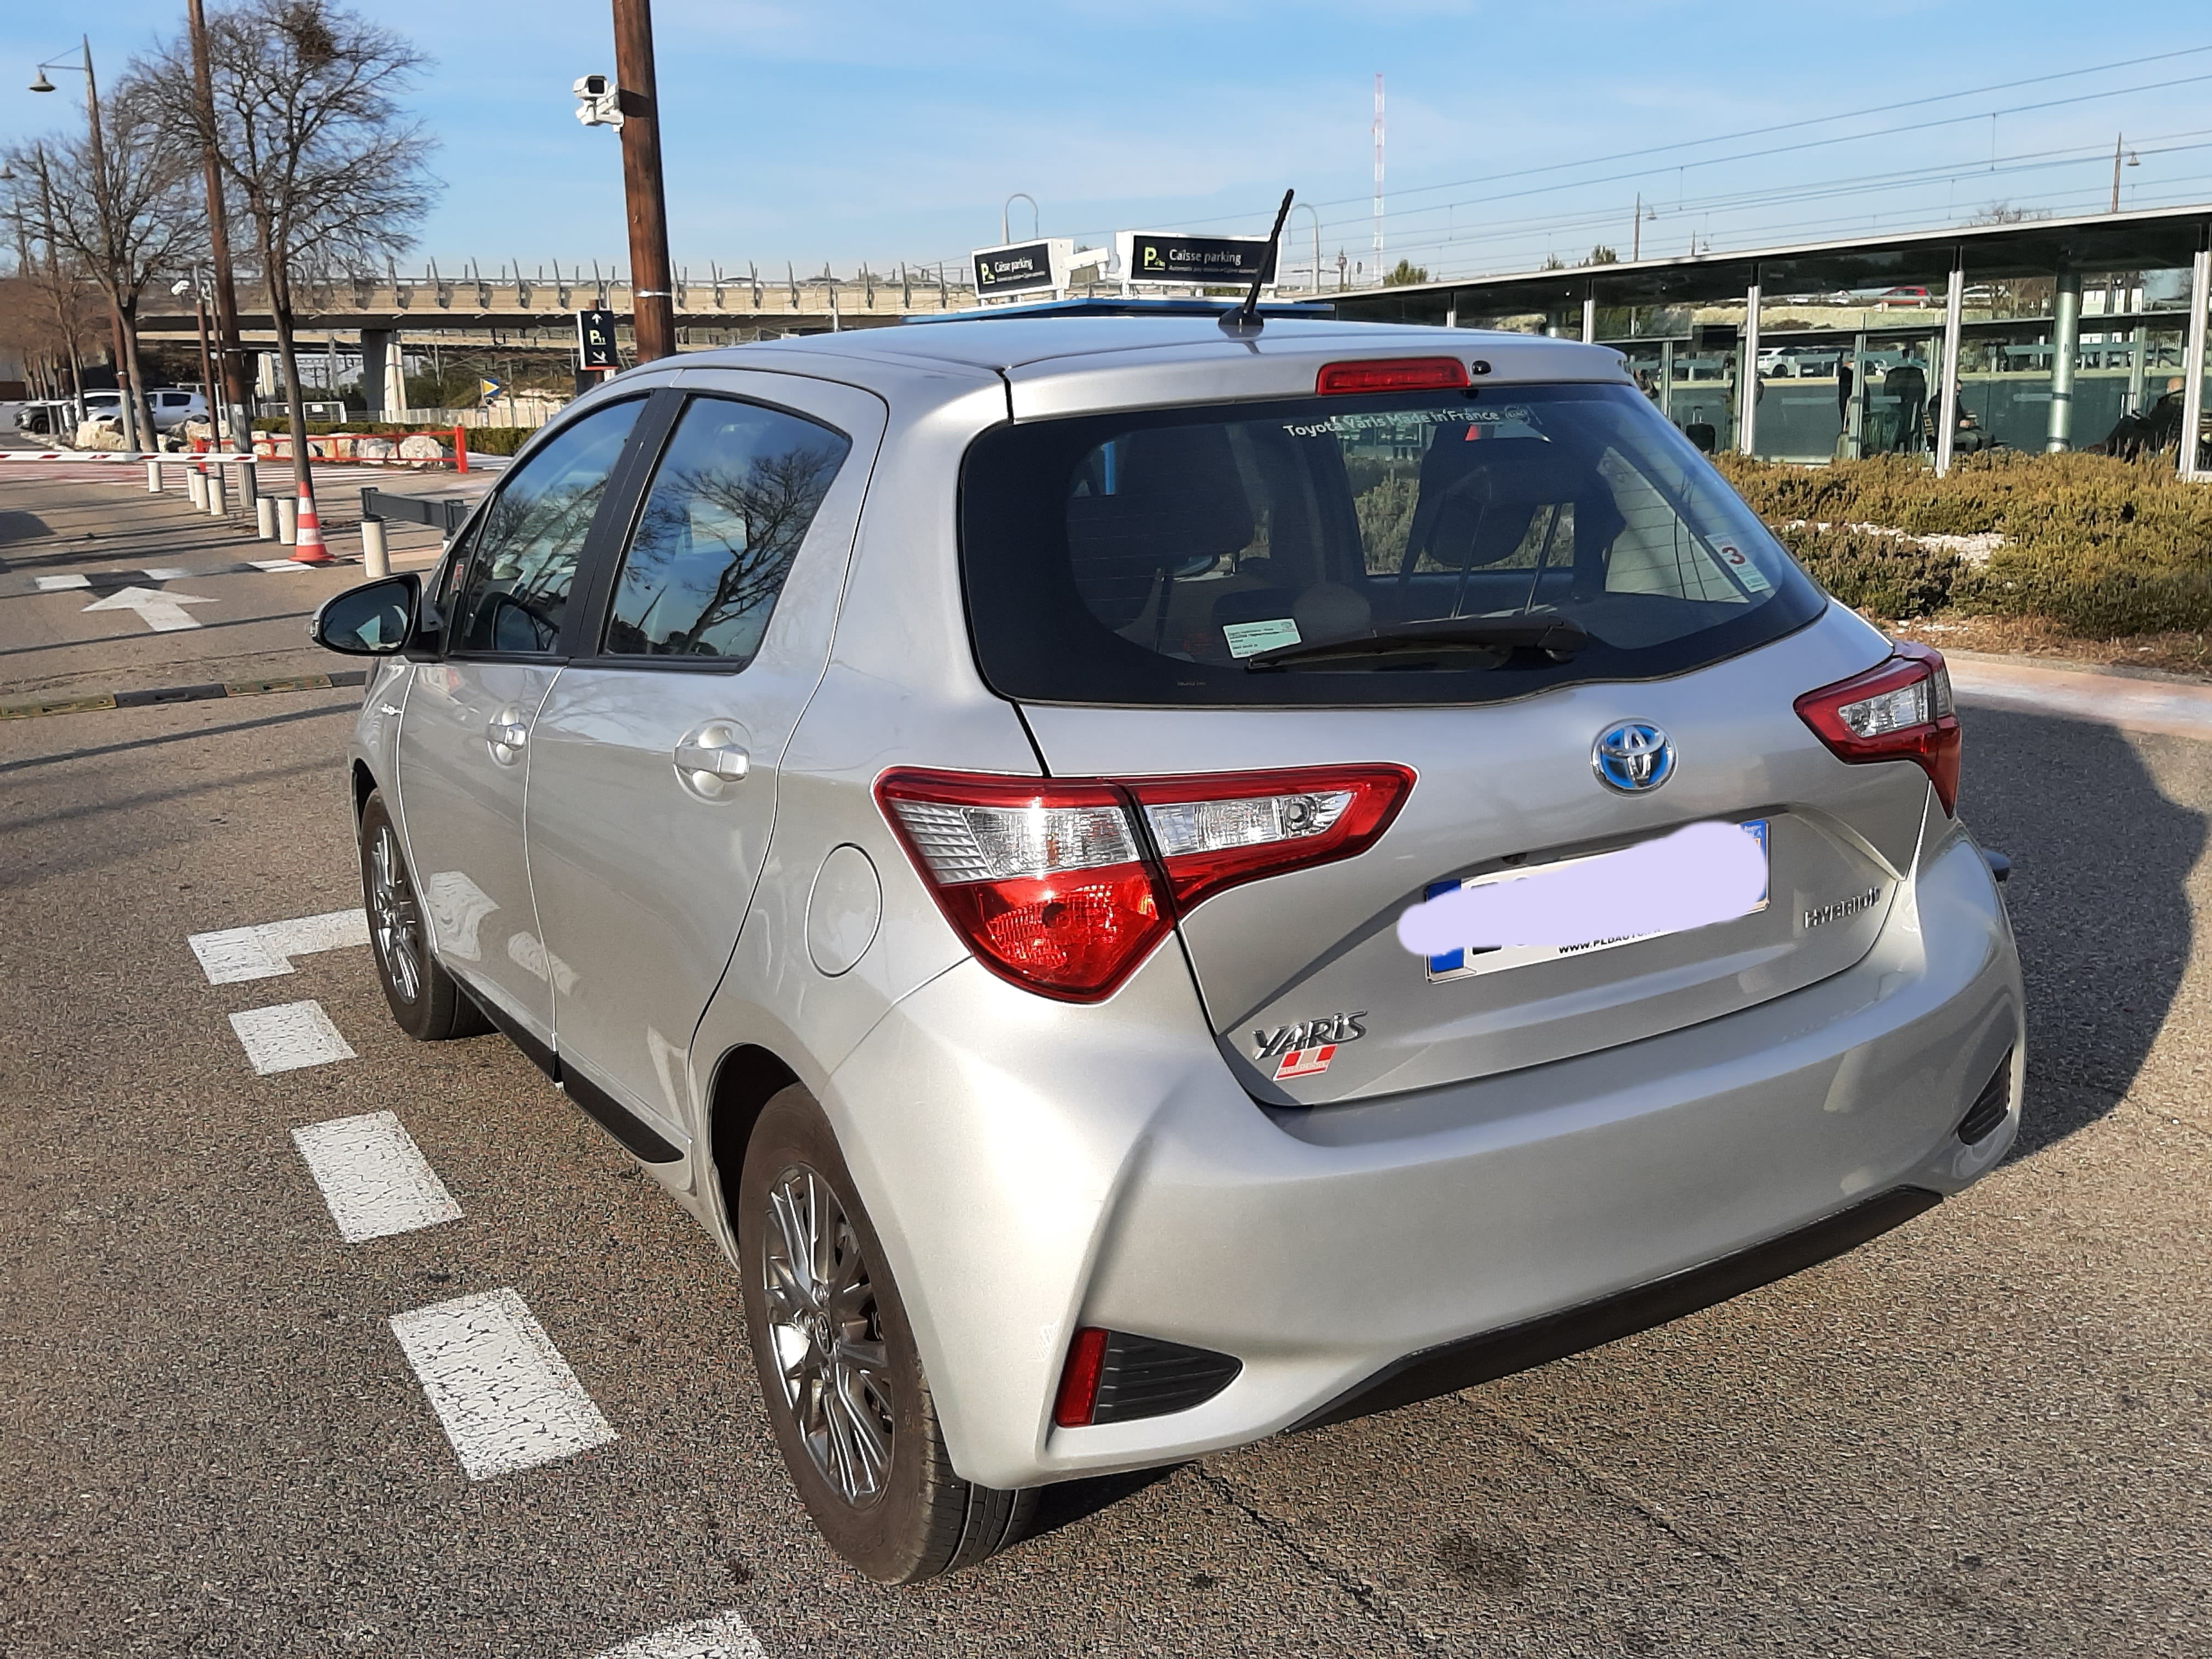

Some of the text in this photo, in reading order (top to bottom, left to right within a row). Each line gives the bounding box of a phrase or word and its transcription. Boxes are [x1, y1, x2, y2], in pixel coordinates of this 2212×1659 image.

[1169, 249, 1201, 261] Caisse
[1204, 251, 1242, 266] parking
[1283, 420, 1344, 437] Toyota
[1343, 415, 1386, 428] Yaris
[1385, 413, 1430, 425] Made
[1446, 410, 1500, 421] France
[1722, 546, 1746, 565] 3
[1804, 886, 1881, 929] HYBRID
